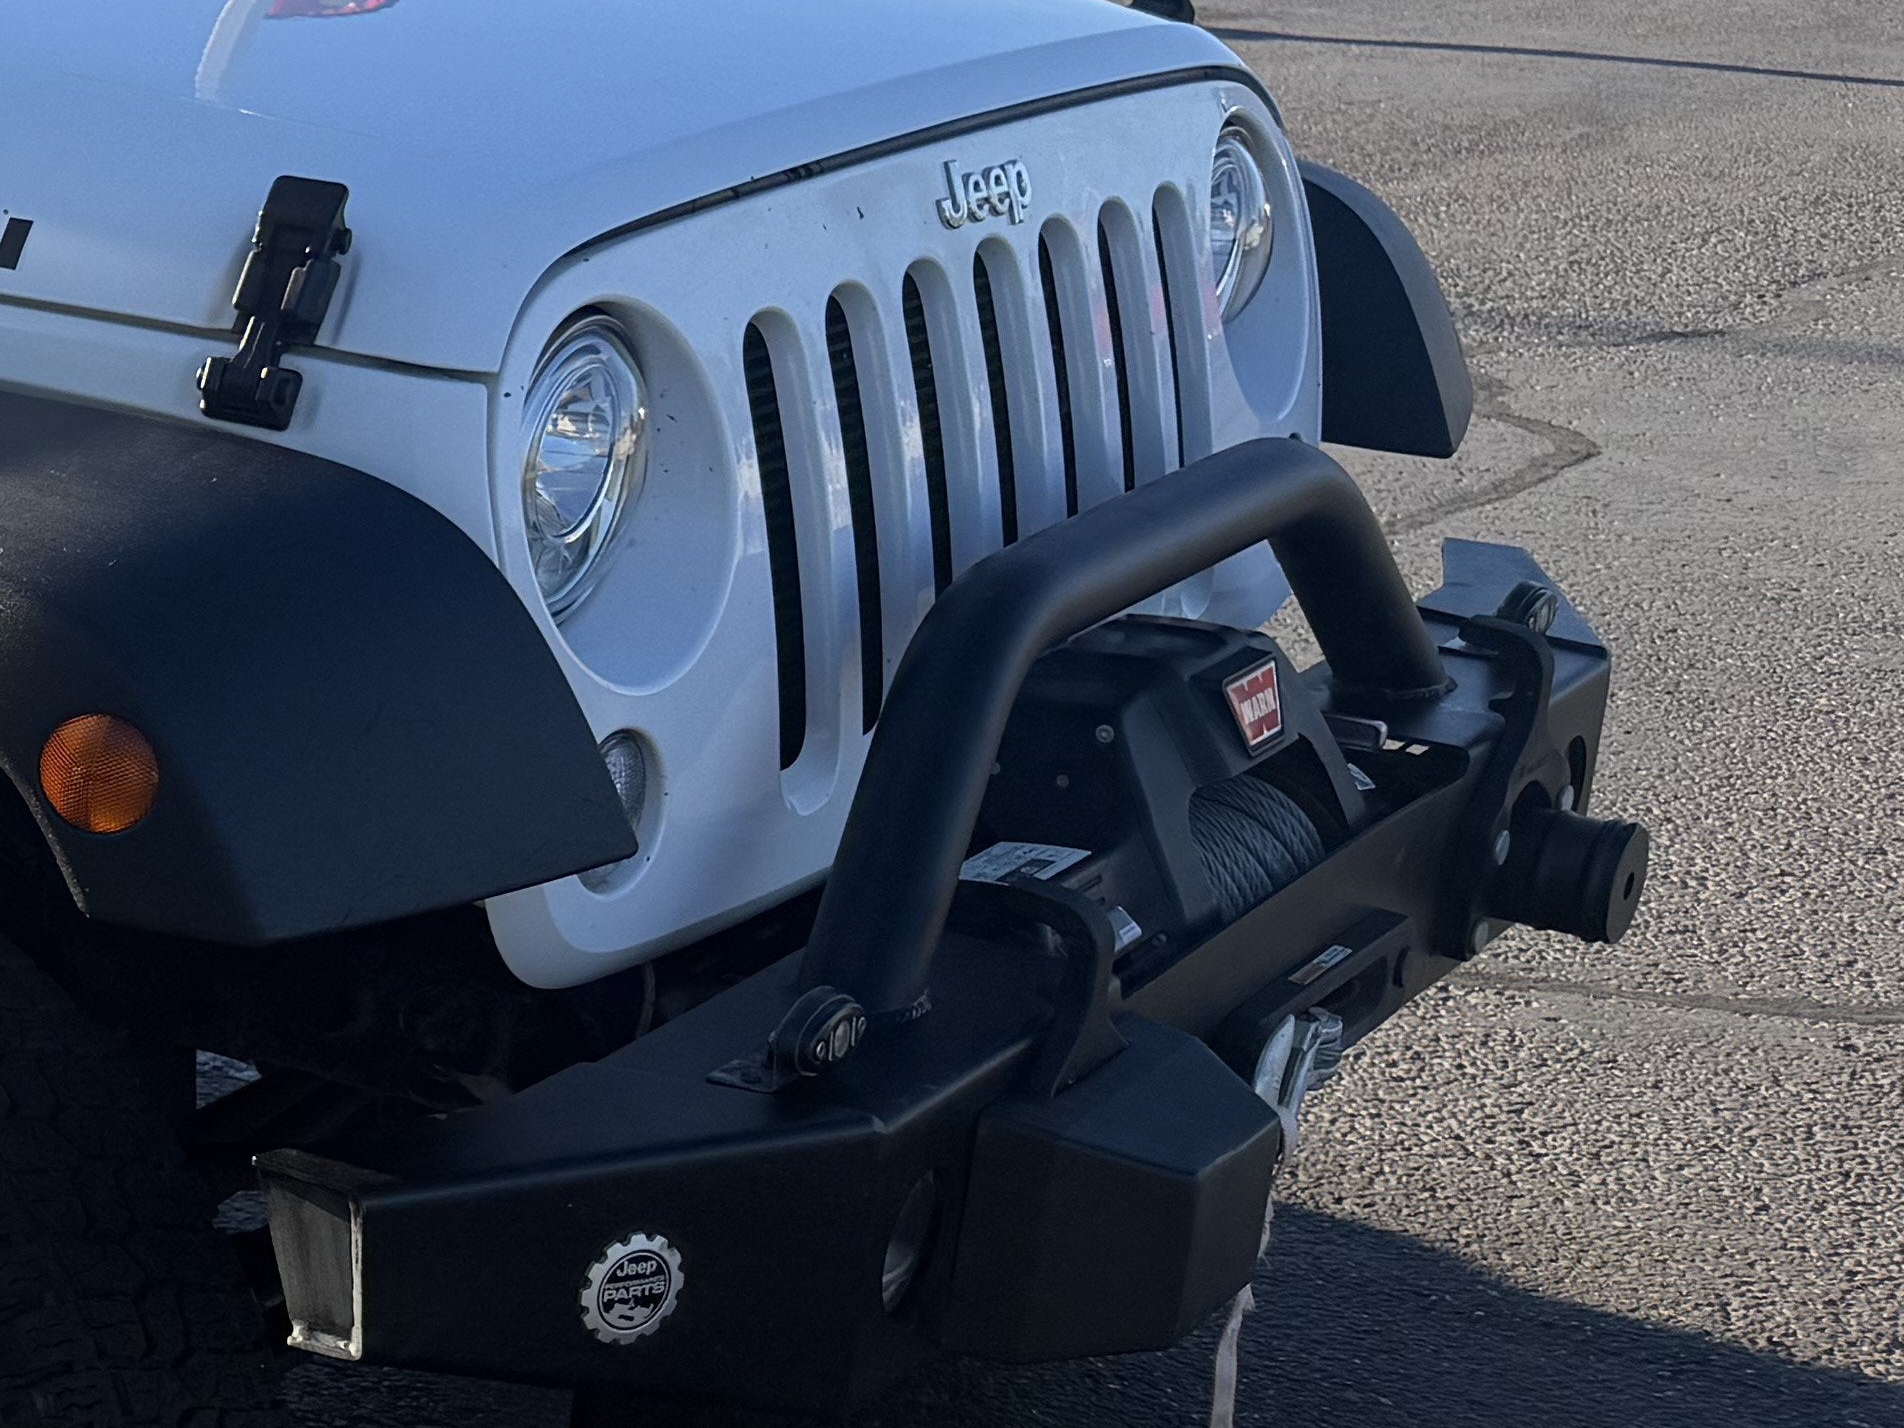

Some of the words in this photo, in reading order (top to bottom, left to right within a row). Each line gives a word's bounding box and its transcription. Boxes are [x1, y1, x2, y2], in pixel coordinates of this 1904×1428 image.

[935, 158, 1033, 230] Jeep
[1239, 686, 1277, 726] WARN
[615, 1259, 658, 1278] Jeep
[603, 1280, 666, 1303] PARTS
